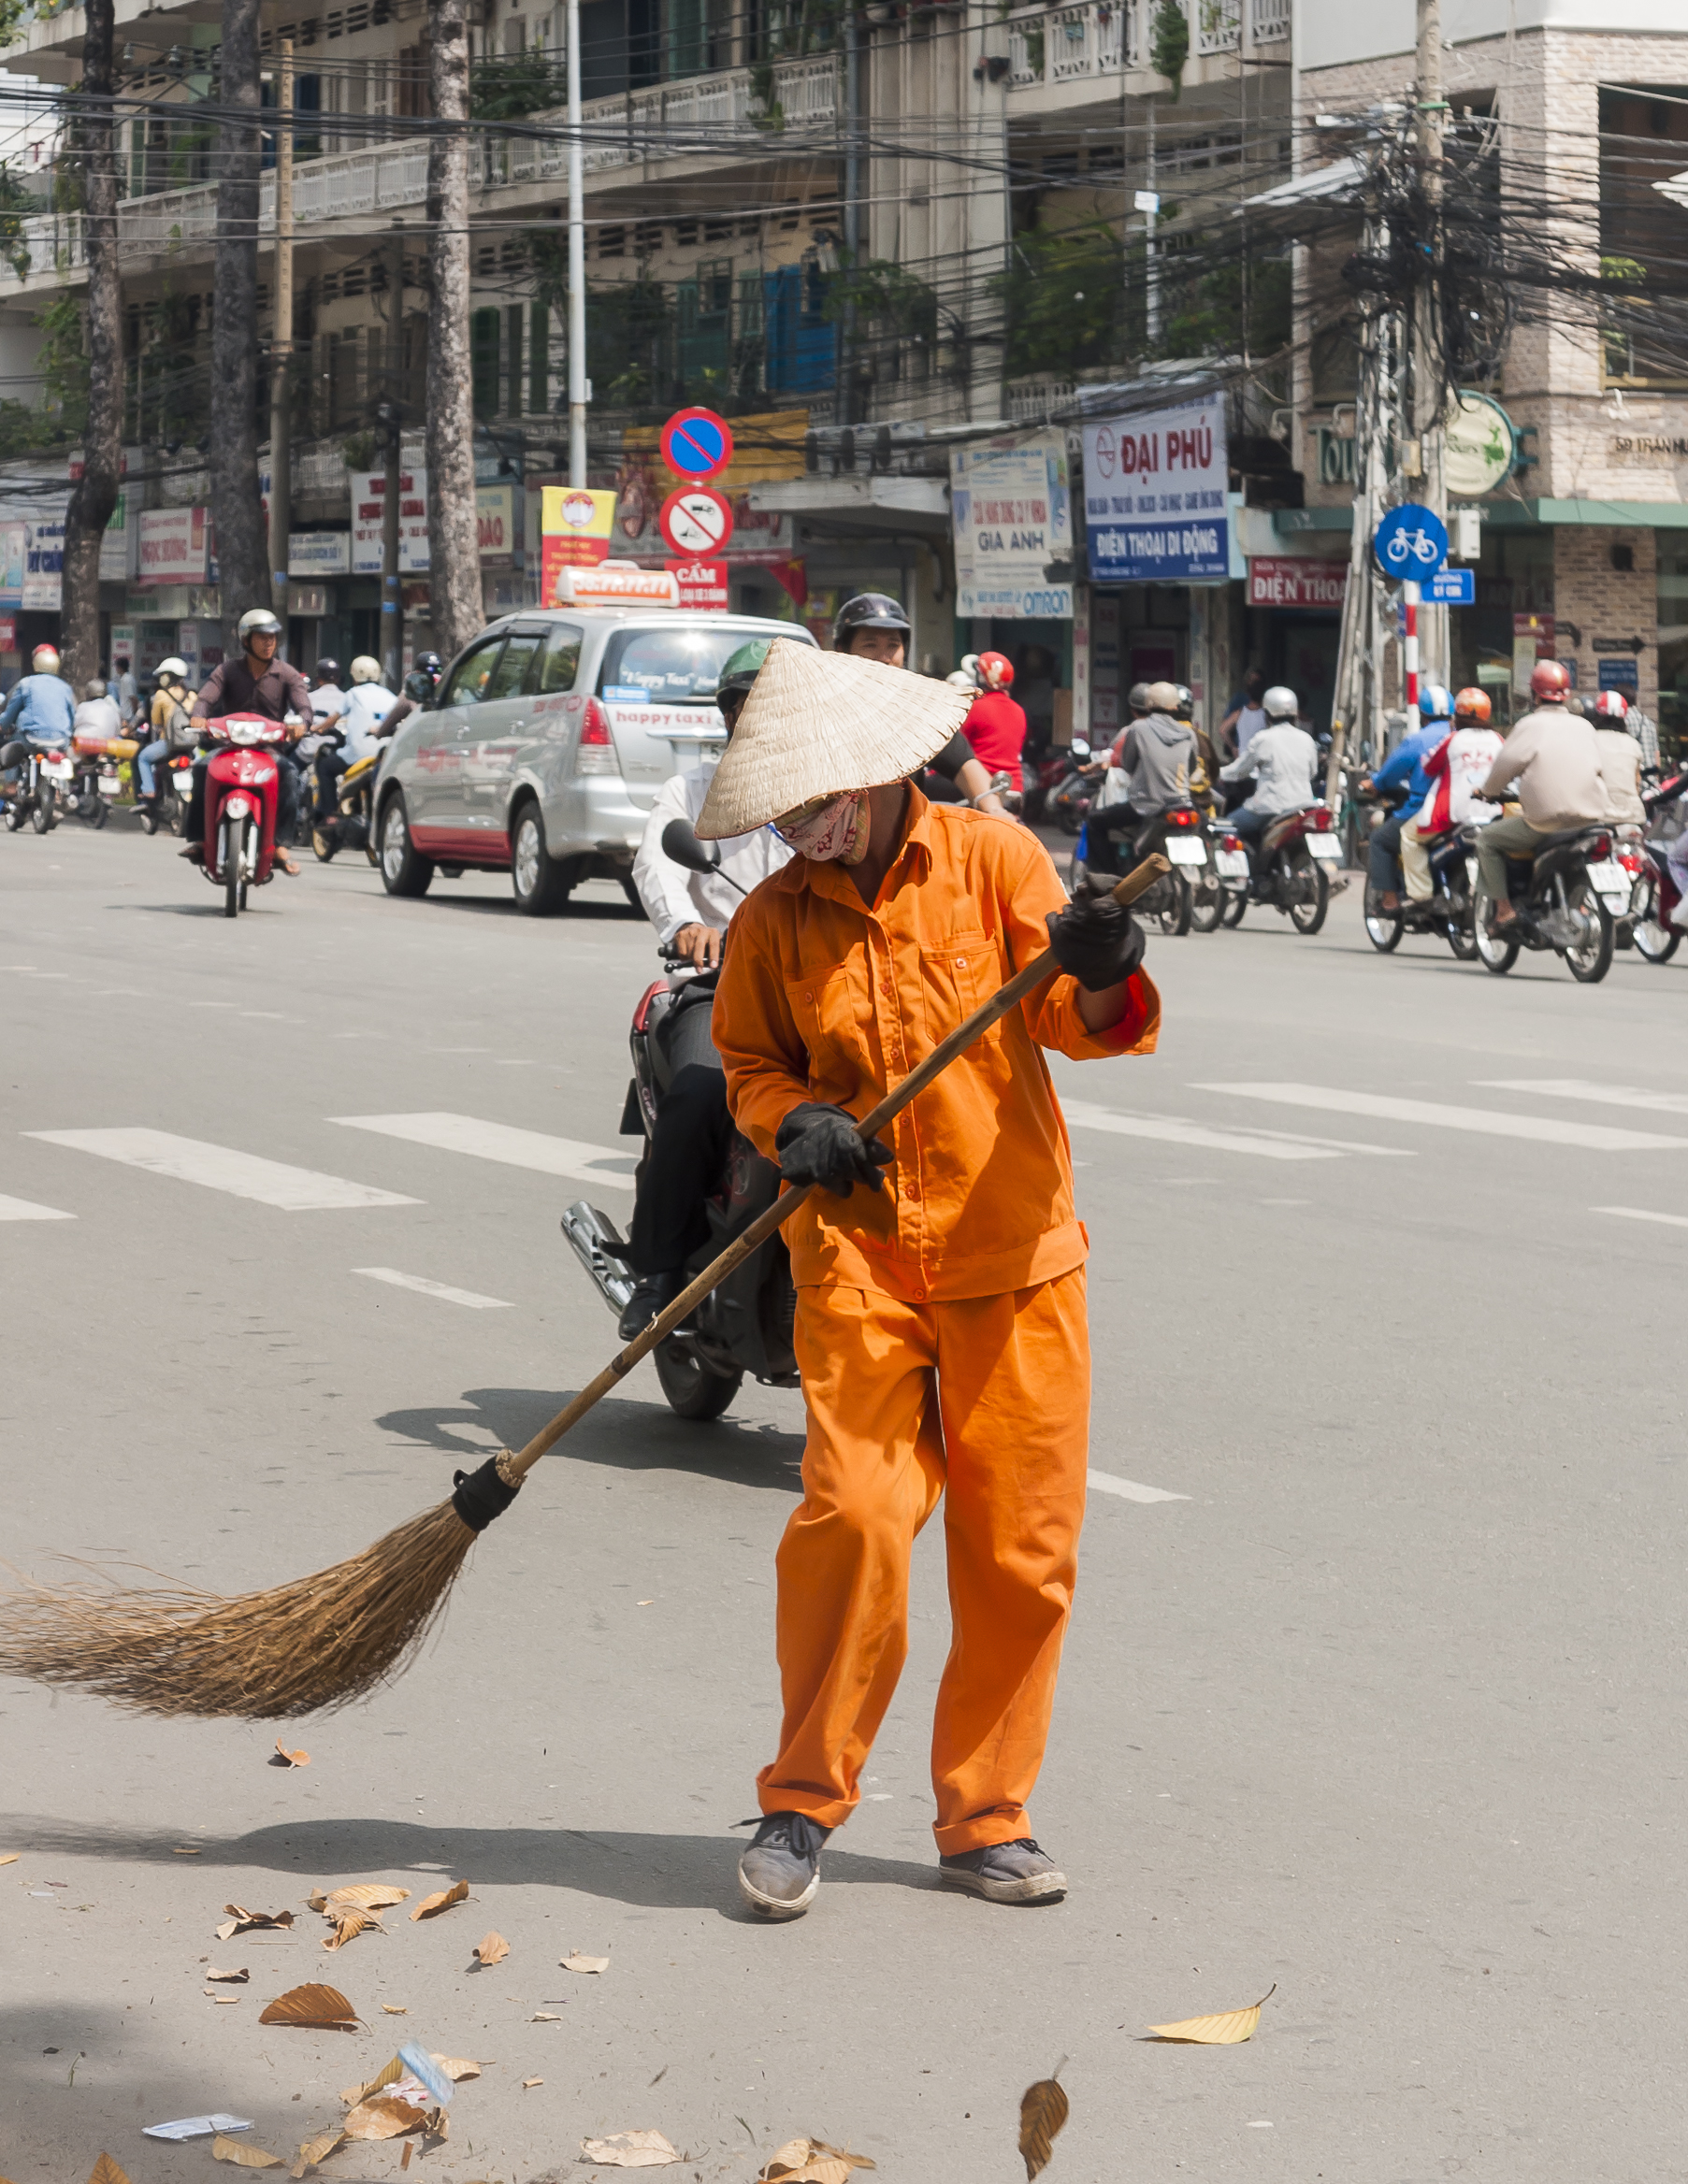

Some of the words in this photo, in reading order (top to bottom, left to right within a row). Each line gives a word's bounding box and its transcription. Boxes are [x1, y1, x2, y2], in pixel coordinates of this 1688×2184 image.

[1121, 432, 1160, 484] ĐẠI
[1166, 414, 1212, 471] PHÚ
[977, 531, 1004, 552] GIA
[1010, 529, 1045, 551] ANH
[676, 562, 716, 583] CẤM
[616, 711, 671, 725] happy
[675, 711, 712, 724] taxi
